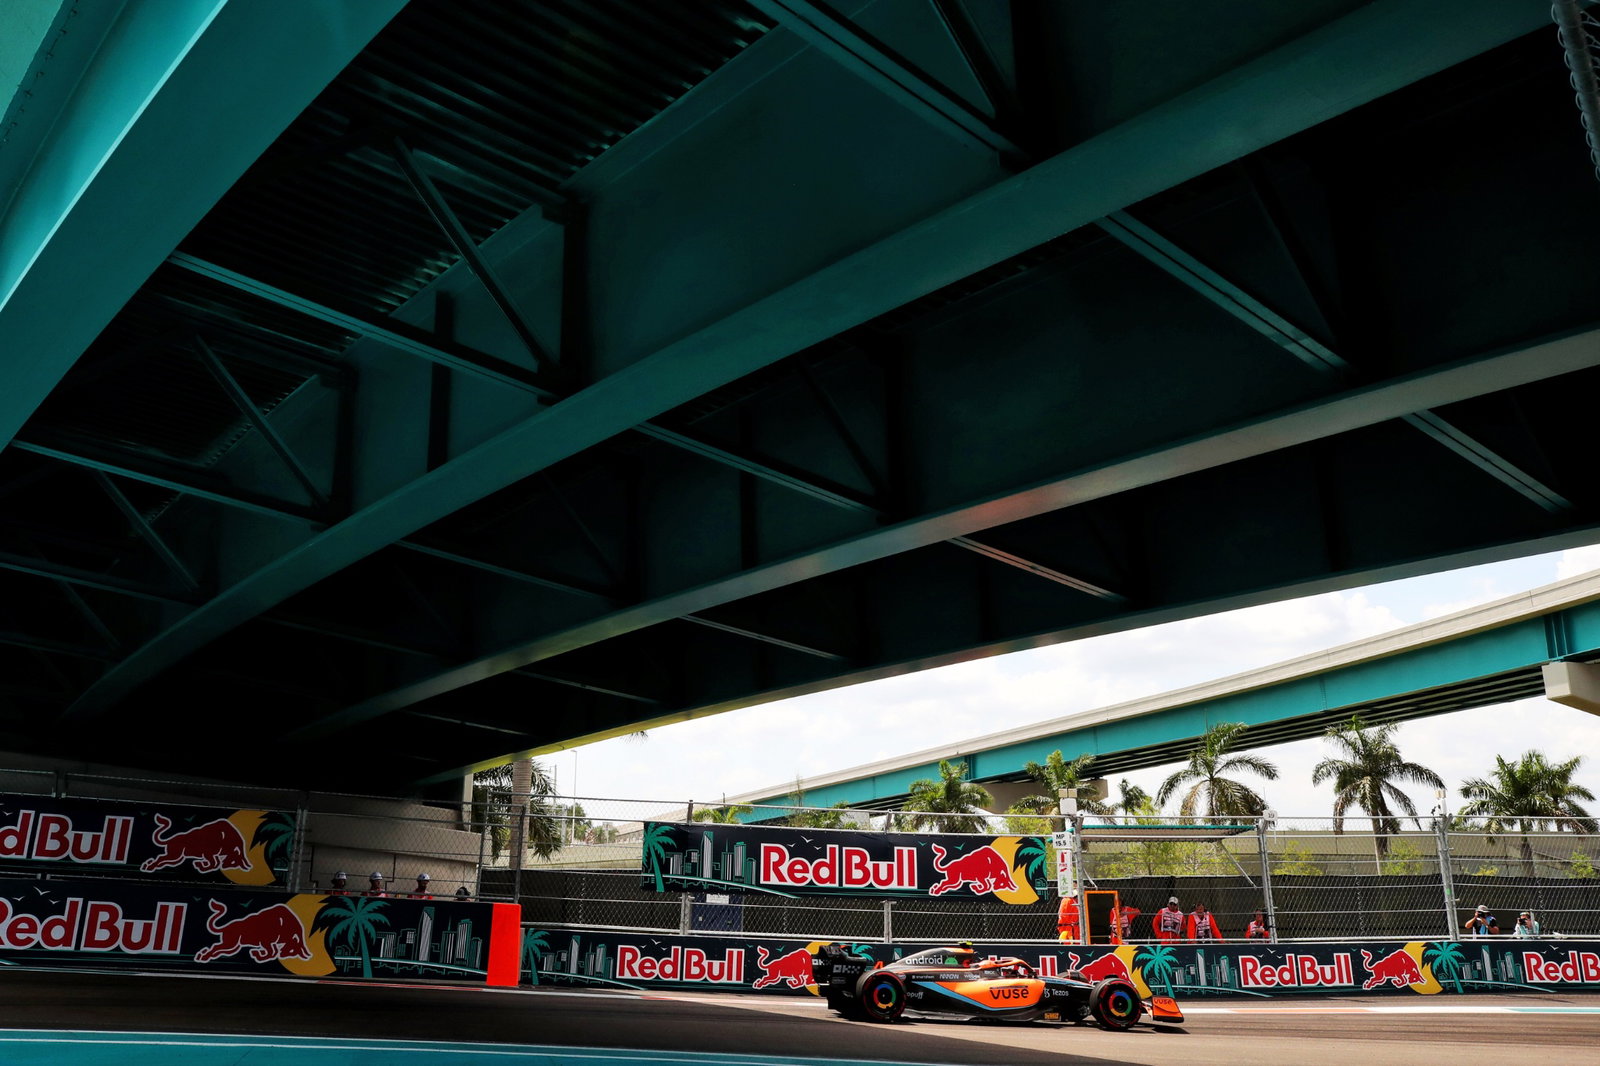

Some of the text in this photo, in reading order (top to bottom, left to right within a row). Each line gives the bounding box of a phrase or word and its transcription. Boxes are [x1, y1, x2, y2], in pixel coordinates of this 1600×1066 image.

[905, 955, 943, 965] android
[832, 964, 861, 974] OKX
[906, 991, 924, 999] opuff
[1052, 988, 1069, 997] Tezos
